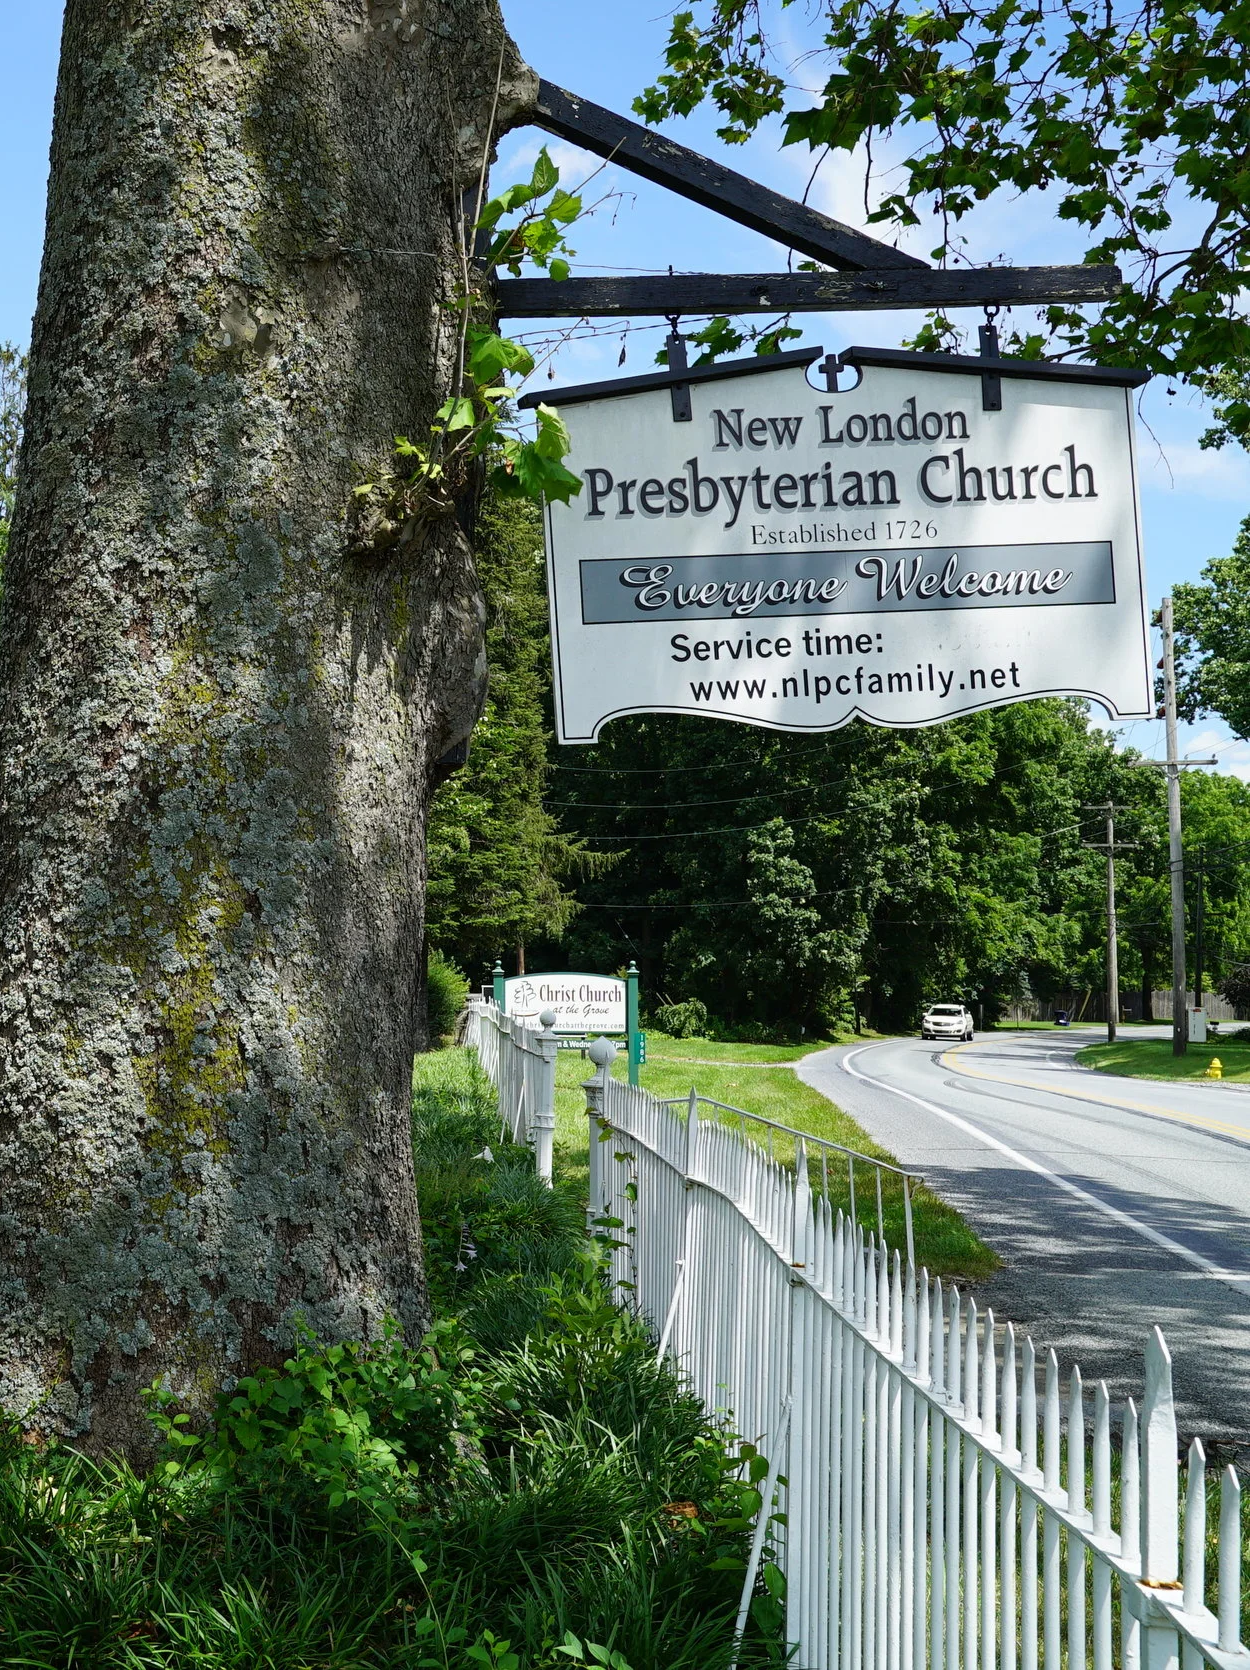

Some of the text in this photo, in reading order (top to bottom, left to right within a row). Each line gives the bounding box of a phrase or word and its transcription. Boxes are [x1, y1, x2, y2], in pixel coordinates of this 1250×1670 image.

[710, 396, 970, 451] New London
[582, 444, 1098, 531] Presbyterian Church
[751, 519, 938, 545] Established 1726
[619, 552, 1073, 617] Everyone Welcome
[670, 627, 883, 662] Service time:
[689, 660, 1021, 704] www.nlpcfamily.net
[539, 984, 622, 1003] Christ Church
[552, 1003, 610, 1018] at the Grove
